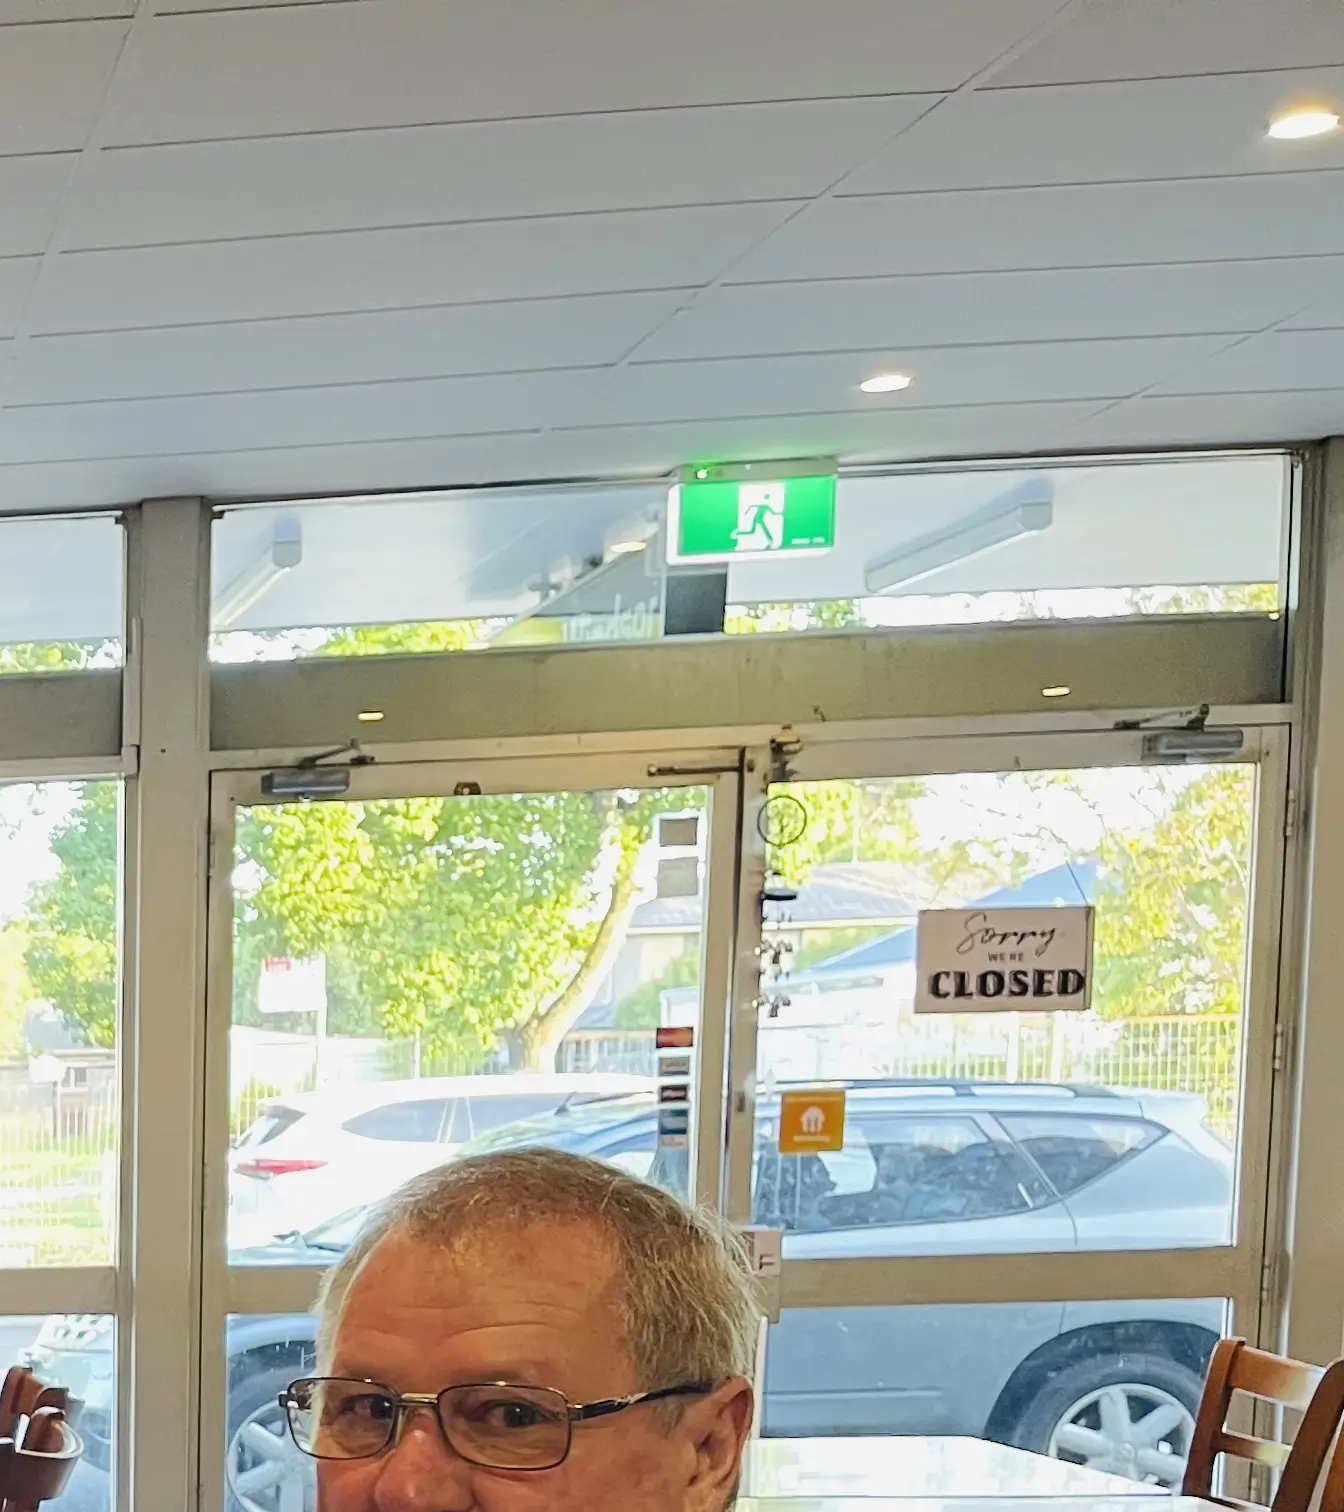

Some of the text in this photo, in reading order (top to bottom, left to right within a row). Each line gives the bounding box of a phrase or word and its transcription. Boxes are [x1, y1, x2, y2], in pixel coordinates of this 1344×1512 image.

[955, 911, 1057, 958] Sorry
[987, 951, 1025, 963] WERE
[928, 968, 1086, 999] CLOSED
